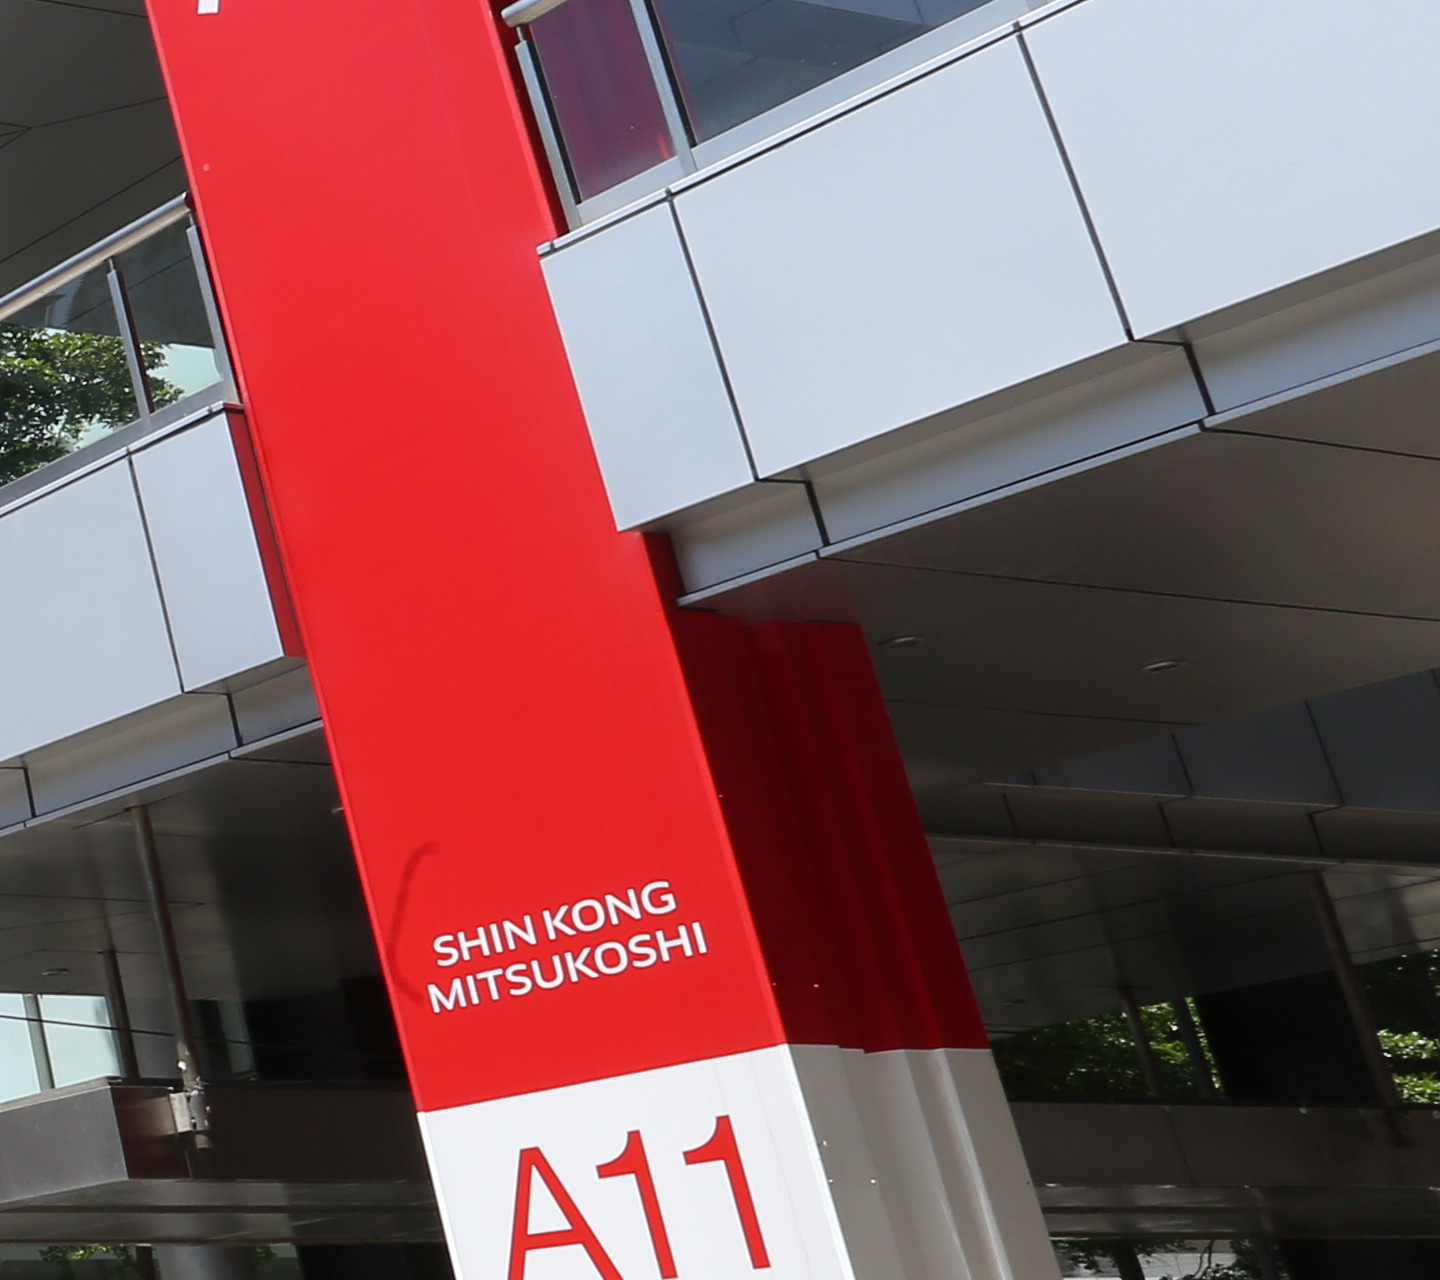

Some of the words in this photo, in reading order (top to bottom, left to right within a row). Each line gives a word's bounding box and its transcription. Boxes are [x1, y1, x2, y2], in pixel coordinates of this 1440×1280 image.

[426, 921, 709, 1015] MITSUKOSHI
[432, 915, 537, 968] SHIN
[542, 880, 678, 941] KONG
